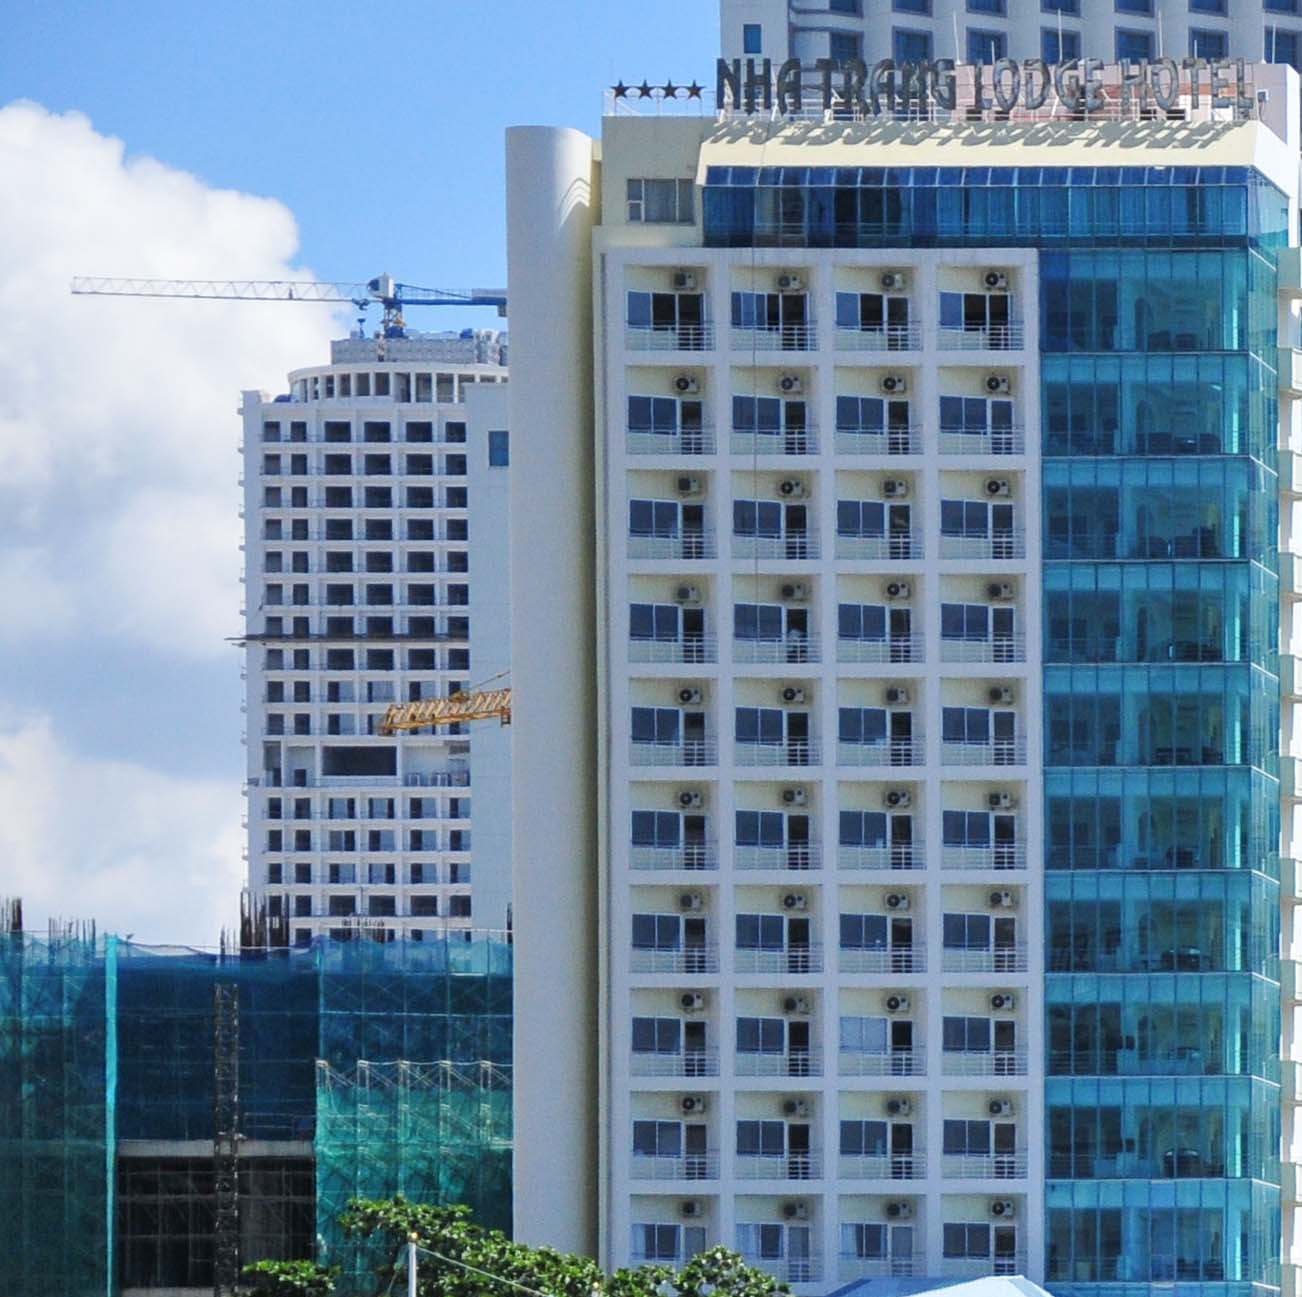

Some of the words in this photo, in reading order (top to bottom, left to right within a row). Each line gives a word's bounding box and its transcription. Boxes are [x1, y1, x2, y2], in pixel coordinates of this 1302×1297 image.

[716, 58, 801, 113] NHA
[814, 58, 957, 116] TRANG
[975, 58, 1104, 112] LODGE
[1120, 57, 1254, 114] HOTEL
